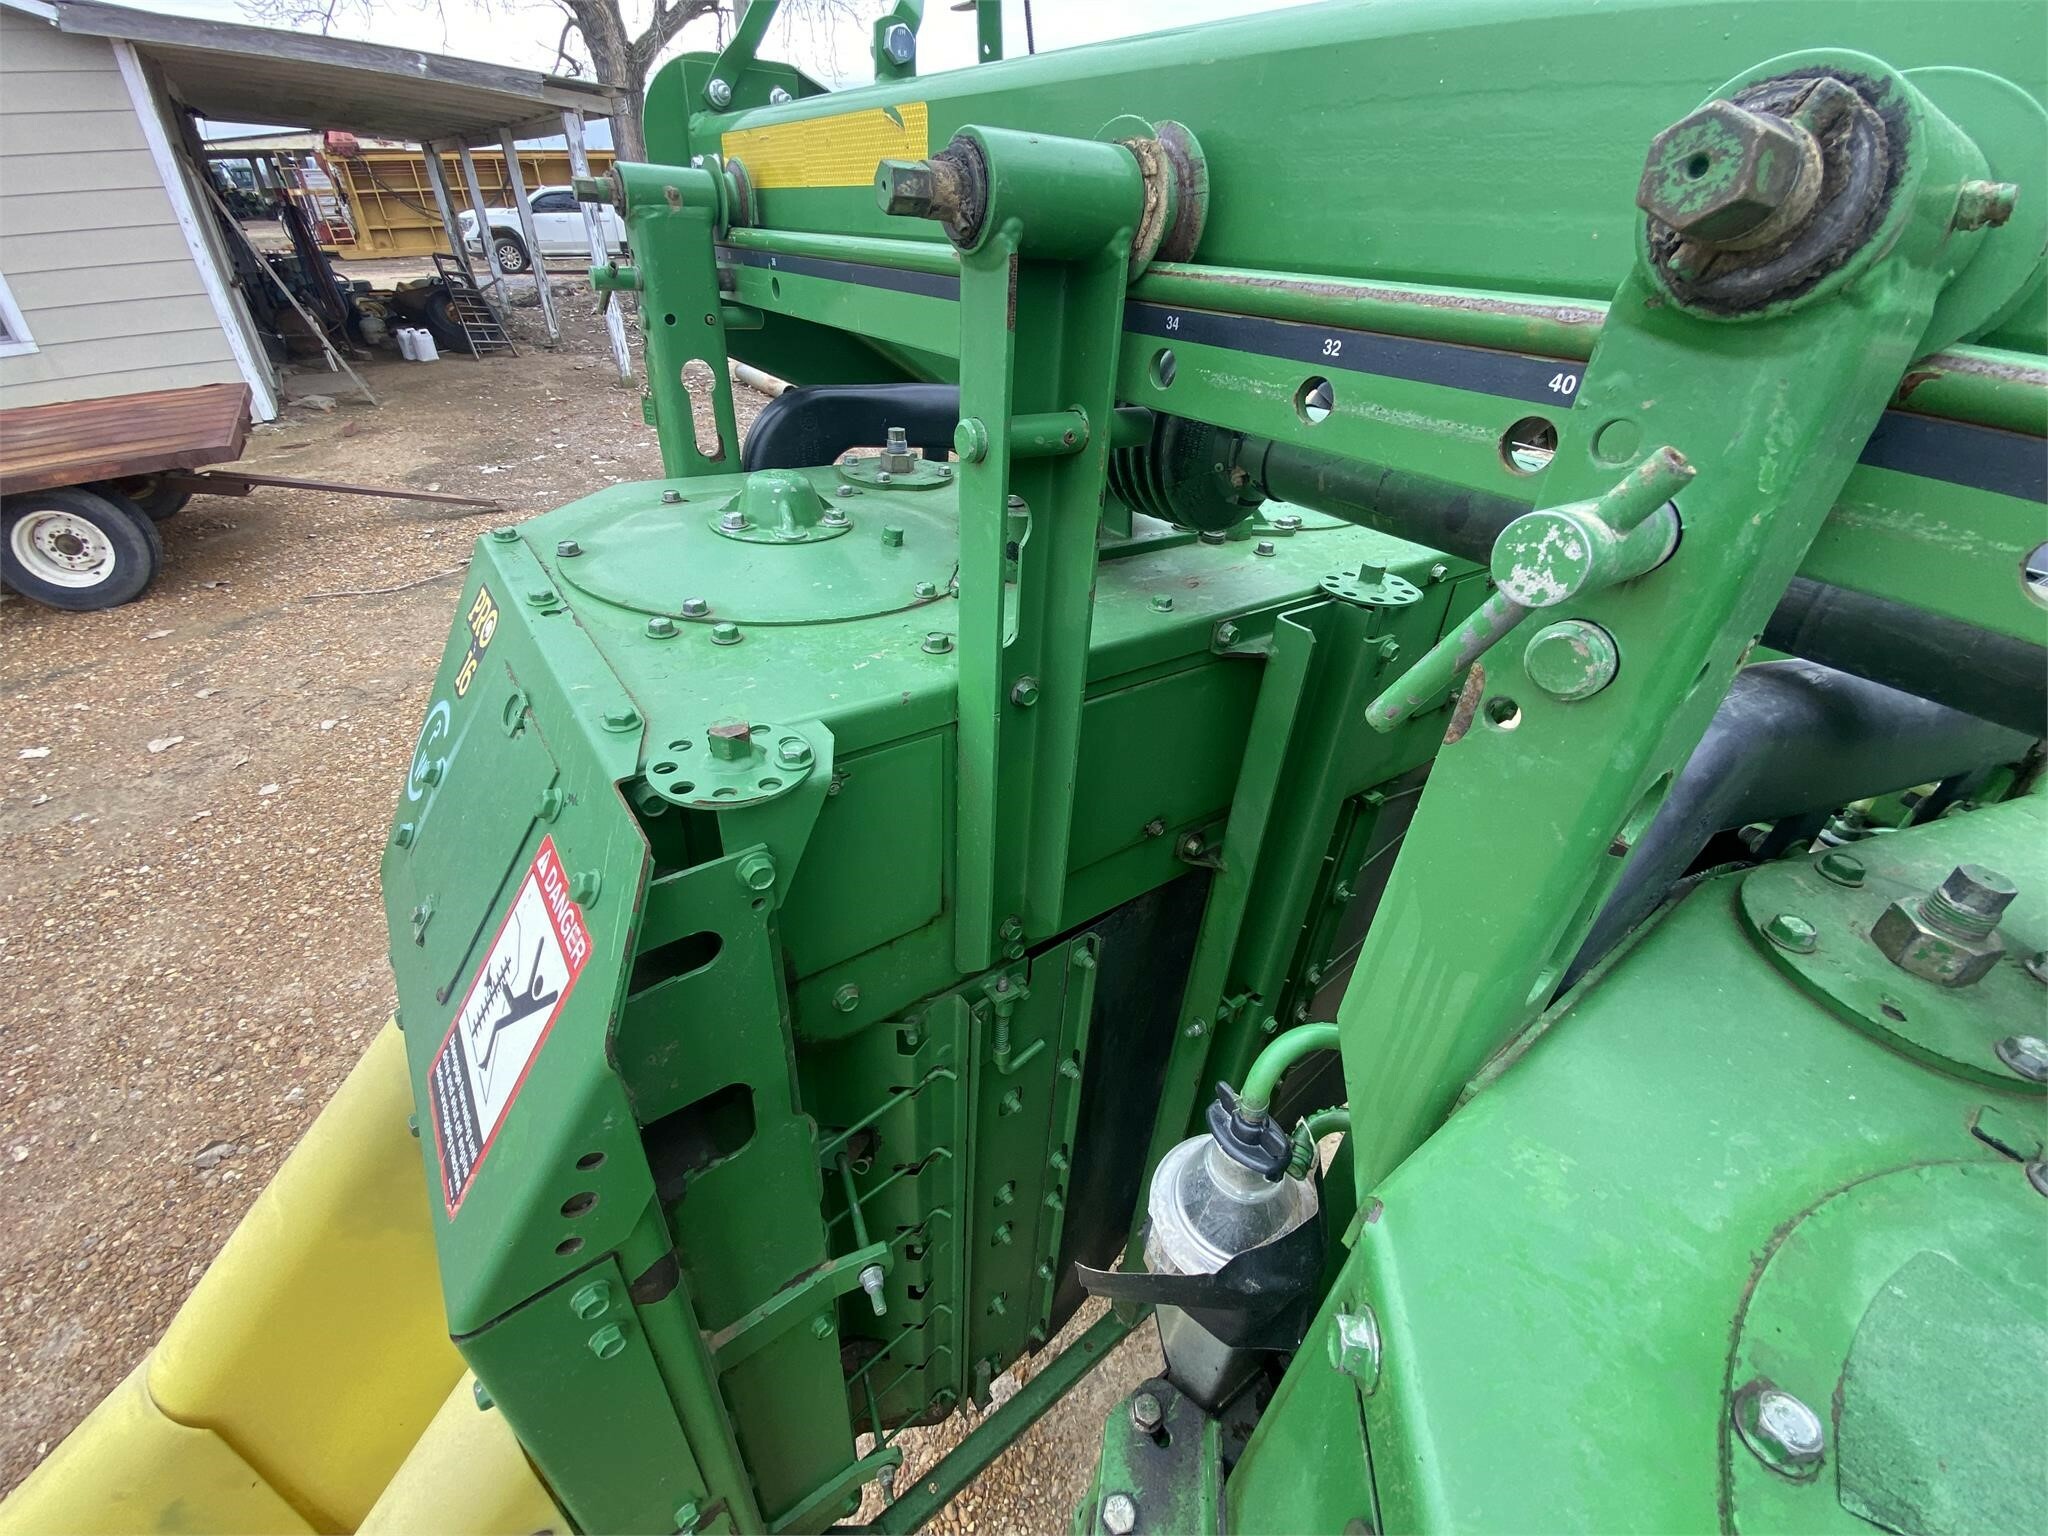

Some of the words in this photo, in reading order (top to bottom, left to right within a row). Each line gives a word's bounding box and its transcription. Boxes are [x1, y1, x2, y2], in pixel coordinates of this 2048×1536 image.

[1166, 315, 1180, 331] 34
[1322, 338, 1342, 357] 32
[1548, 373, 1577, 395] 40
[467, 587, 499, 649] PRO
[455, 649, 478, 696] 16
[543, 865, 587, 970] DANGER
[447, 1074, 456, 1098] and
[455, 1119, 464, 1138] off
[459, 1081, 473, 1142] harvesting
[469, 1137, 479, 1164] unit
[458, 1137, 470, 1179] engine
